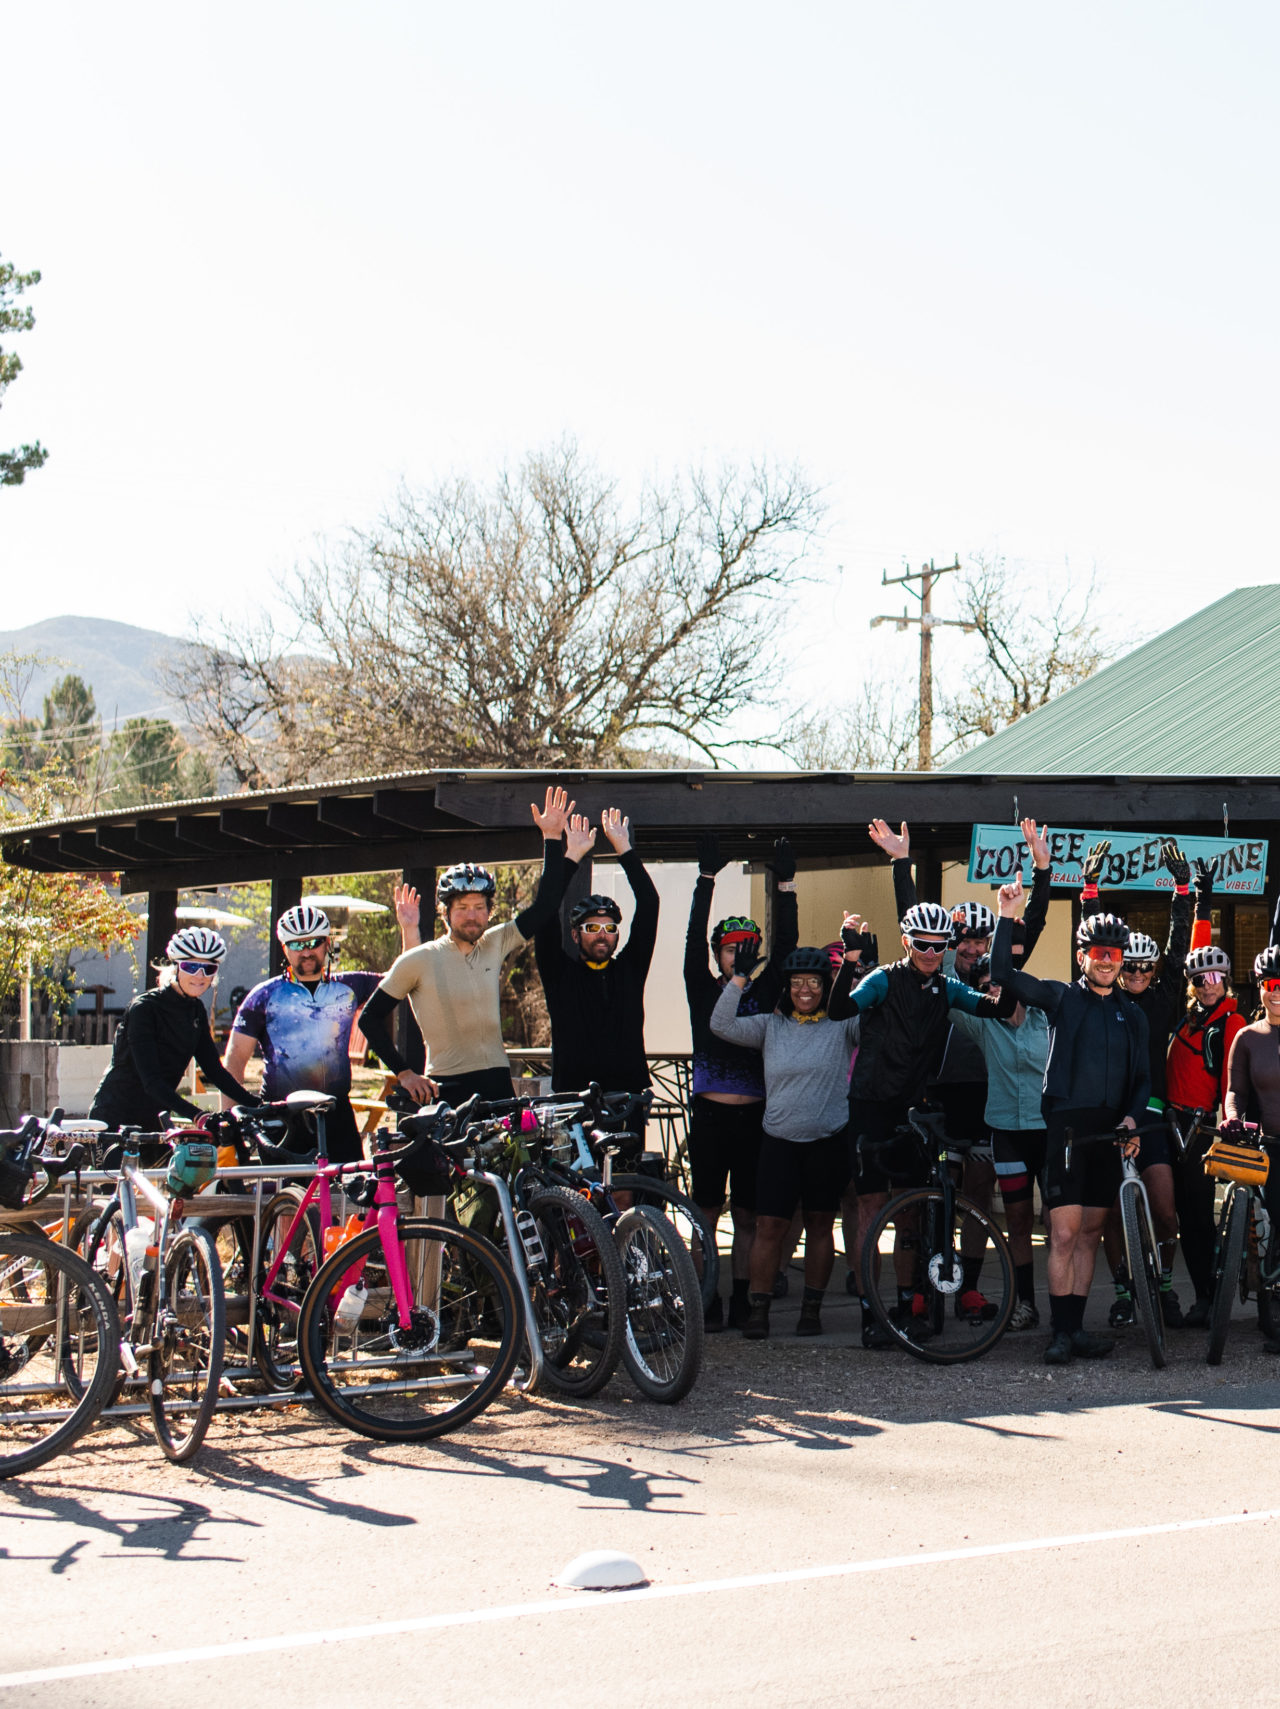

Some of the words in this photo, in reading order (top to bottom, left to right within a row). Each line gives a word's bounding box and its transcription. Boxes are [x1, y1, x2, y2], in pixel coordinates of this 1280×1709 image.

[974, 832, 1086, 880] COFEE
[1225, 879, 1258, 892] VIBES!
[88, 1282, 111, 1331] KENDA
